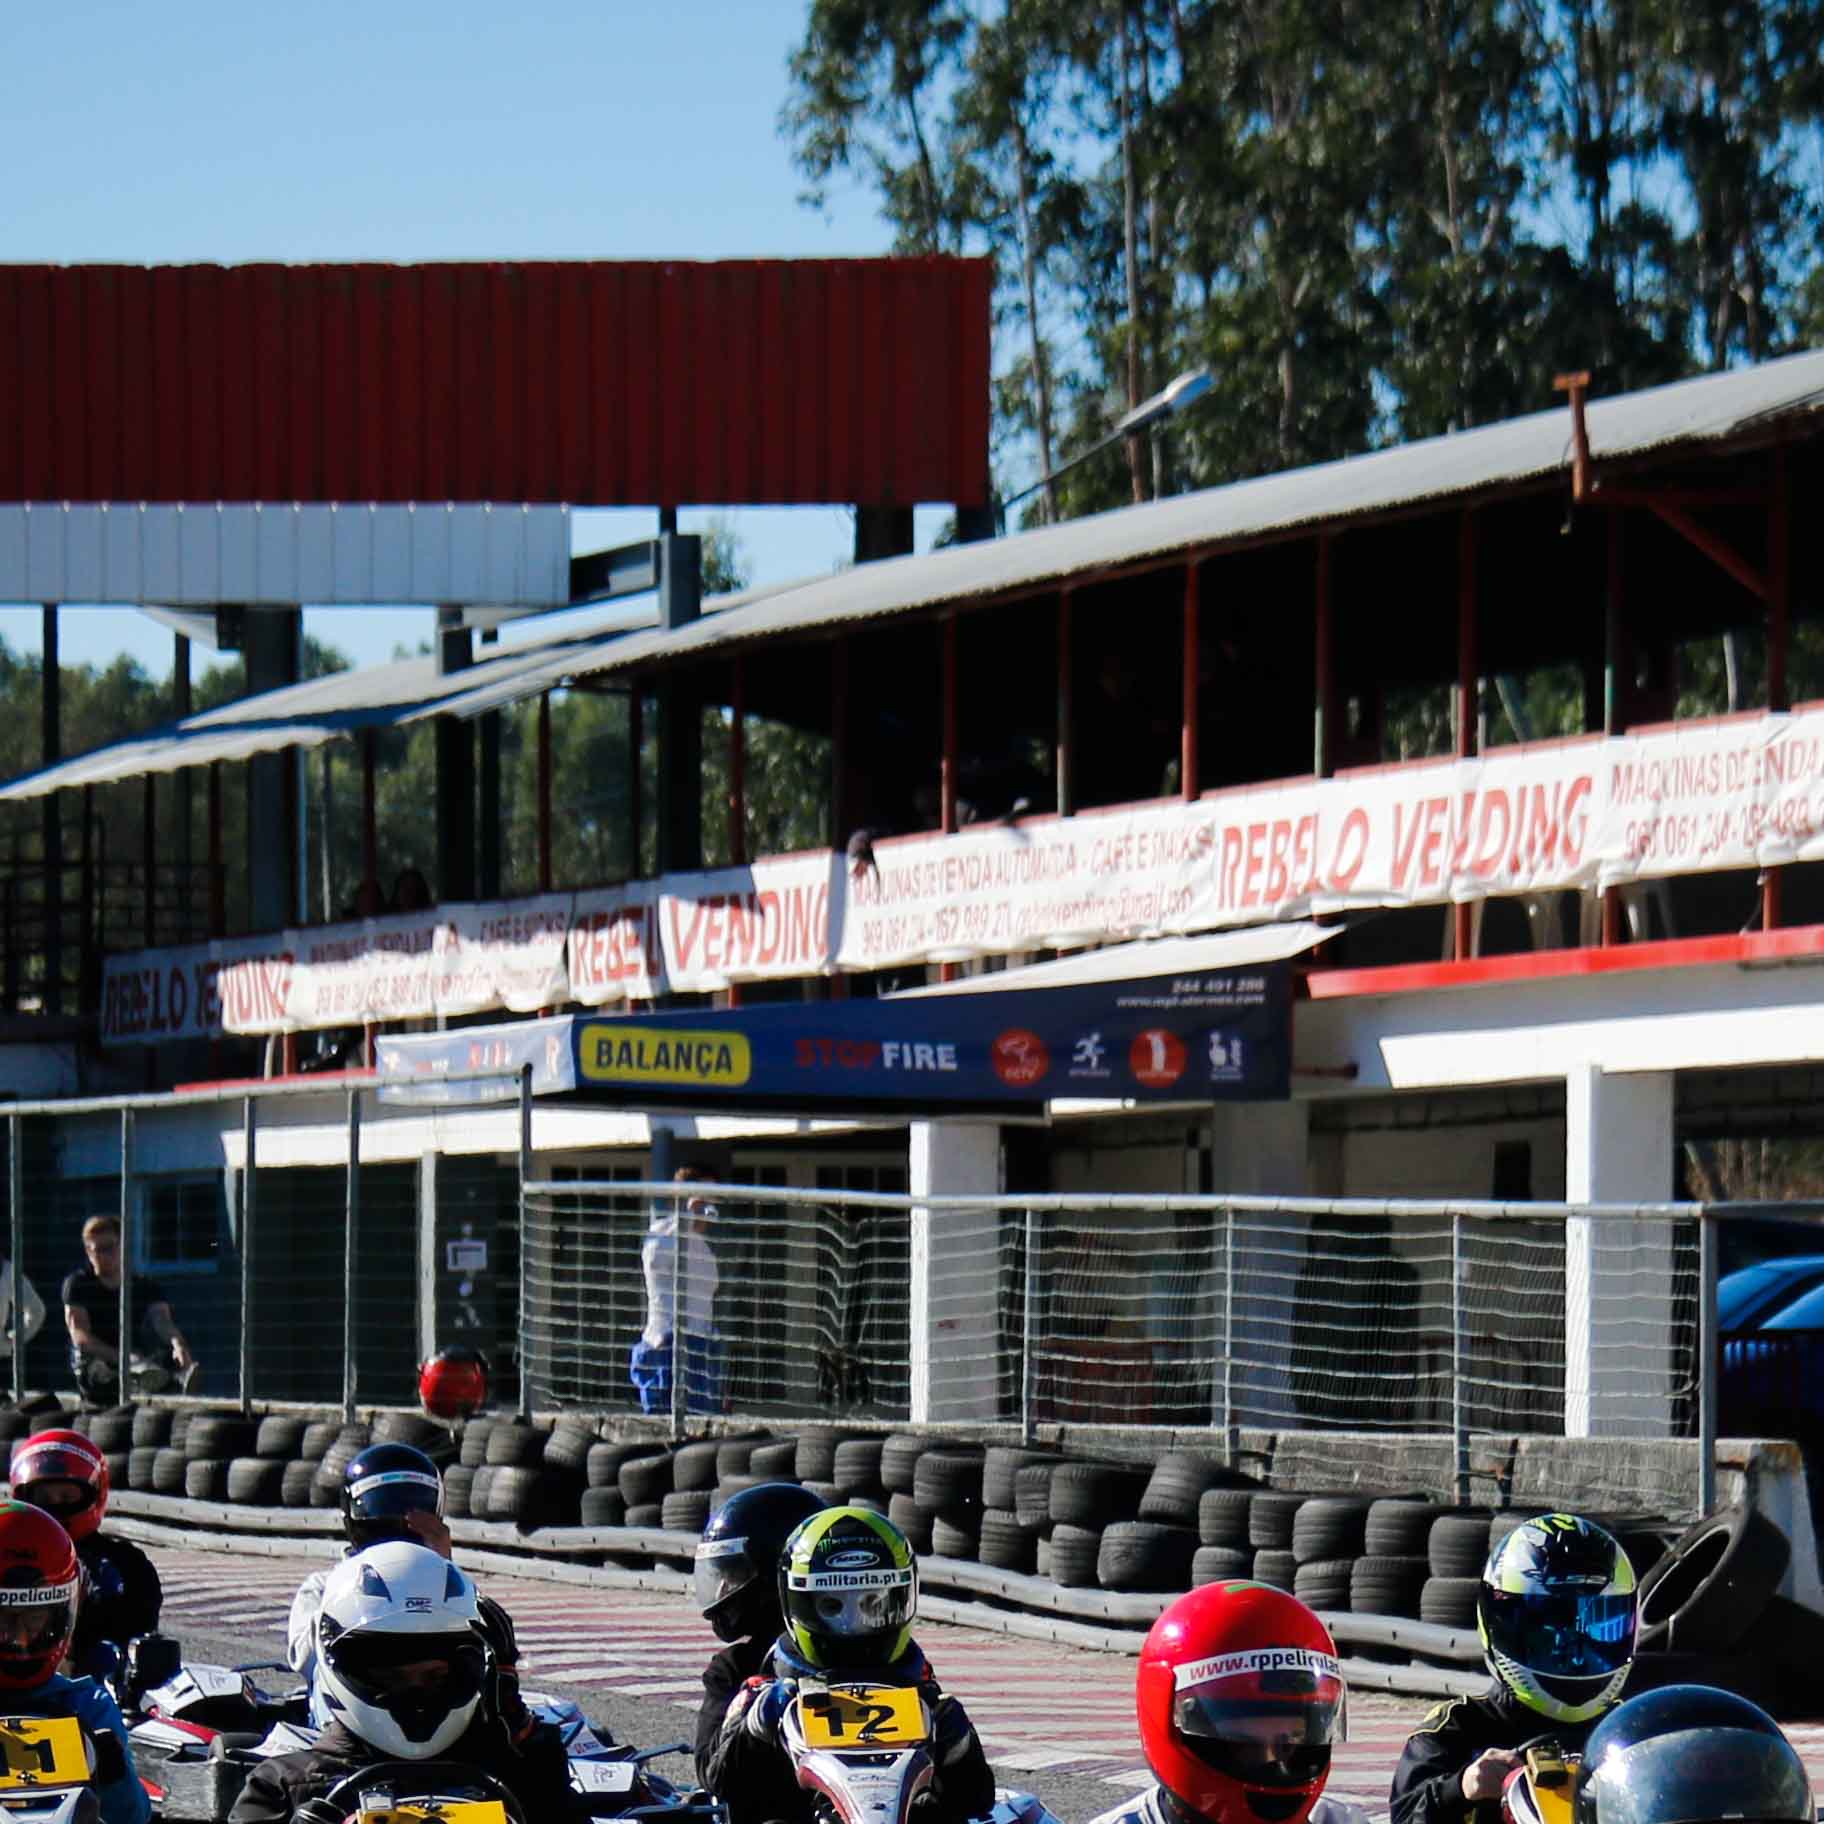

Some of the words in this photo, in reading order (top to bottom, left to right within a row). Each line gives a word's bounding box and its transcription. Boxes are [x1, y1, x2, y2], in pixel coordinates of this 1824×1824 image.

[596, 1040, 733, 1077] BALANÇA
[816, 1572, 896, 1588] militaria.pt
[813, 1704, 898, 1737] 12
